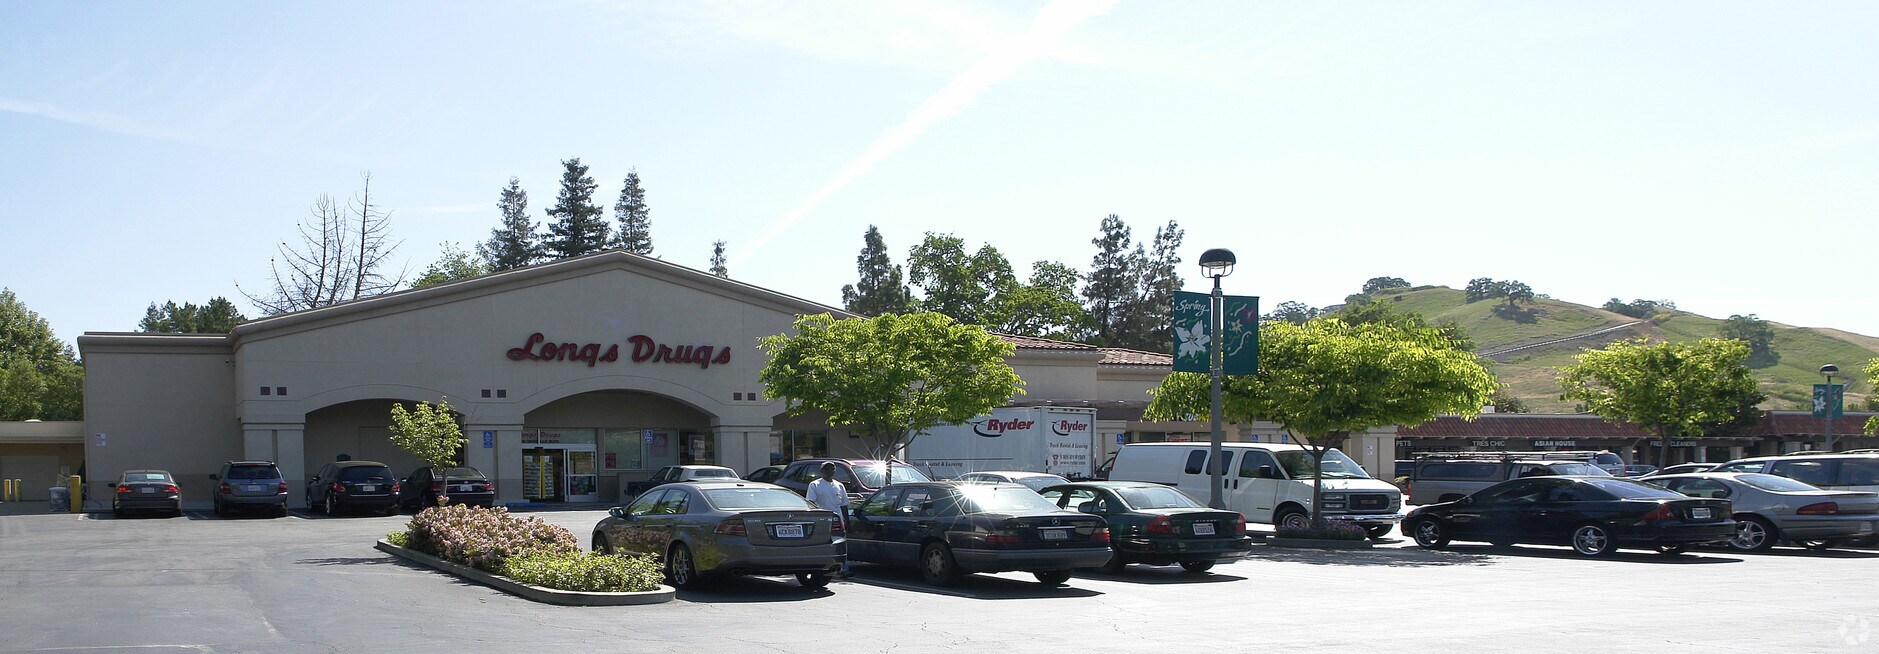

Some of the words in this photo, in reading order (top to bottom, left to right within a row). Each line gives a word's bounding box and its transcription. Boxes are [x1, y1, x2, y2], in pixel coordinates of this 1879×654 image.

[1176, 300, 1210, 316] Spring
[506, 332, 619, 367] Longs
[627, 334, 731, 369] Drugs
[987, 418, 1035, 433] Ryder
[1060, 420, 1088, 432] Ryder
[1490, 440, 1505, 448] CHIC
